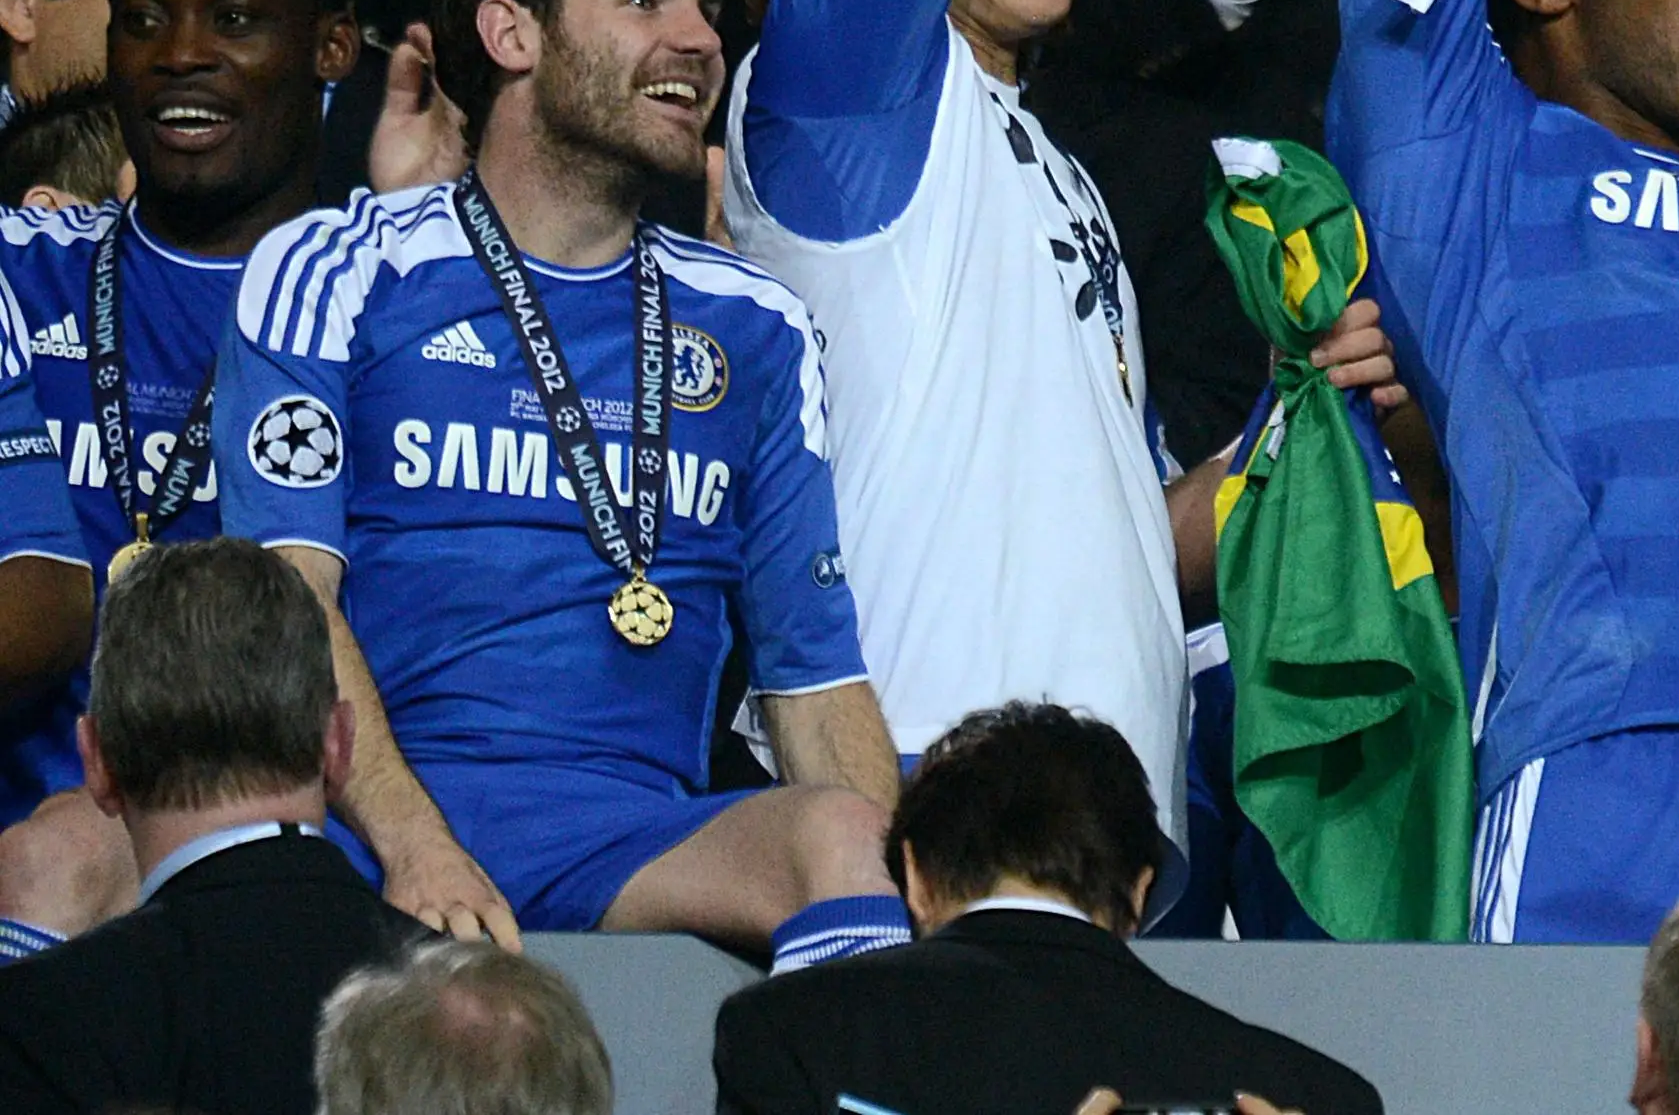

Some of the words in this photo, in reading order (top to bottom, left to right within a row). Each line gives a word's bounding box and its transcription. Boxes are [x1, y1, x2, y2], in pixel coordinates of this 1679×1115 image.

[96, 273, 116, 355] MUNICH
[463, 193, 514, 272] MUNICH
[500, 269, 543, 337] FINAL
[529, 336, 566, 395] 2012
[642, 285, 665, 341] FINAL
[422, 341, 496, 369] adidas
[642, 342, 665, 435] MUNICH
[102, 400, 125, 459] 2012
[511, 389, 542, 404] FINA
[394, 420, 730, 526] SAMUNG
[570, 443, 621, 540] MUNICH
[640, 490, 657, 548] 2012
